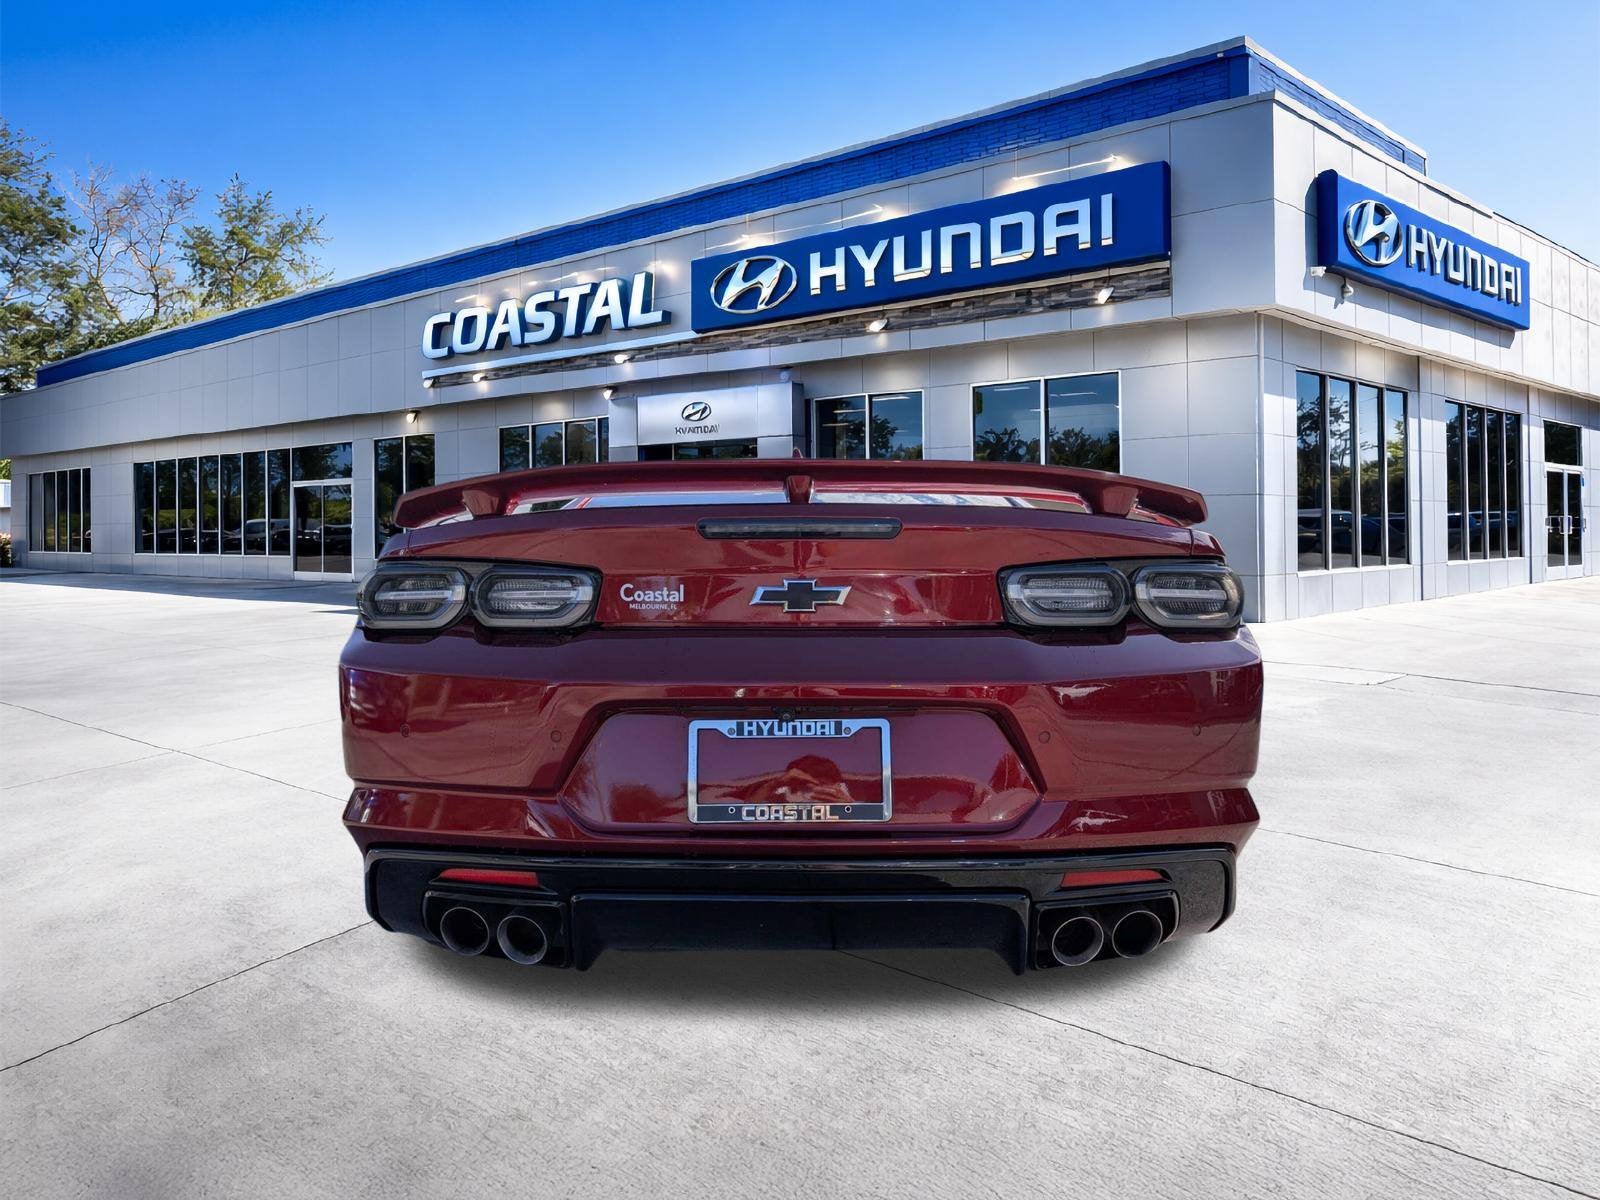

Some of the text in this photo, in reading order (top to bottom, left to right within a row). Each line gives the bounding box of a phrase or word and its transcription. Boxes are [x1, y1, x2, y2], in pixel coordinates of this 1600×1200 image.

[809, 193, 1114, 296] HYUNDAI
[1406, 223, 1522, 306] HYUNDAI
[420, 271, 668, 361] COASTAL
[620, 583, 684, 602] Coastal
[743, 720, 835, 736] HYUNDAI
[742, 805, 839, 820] COASTAL
